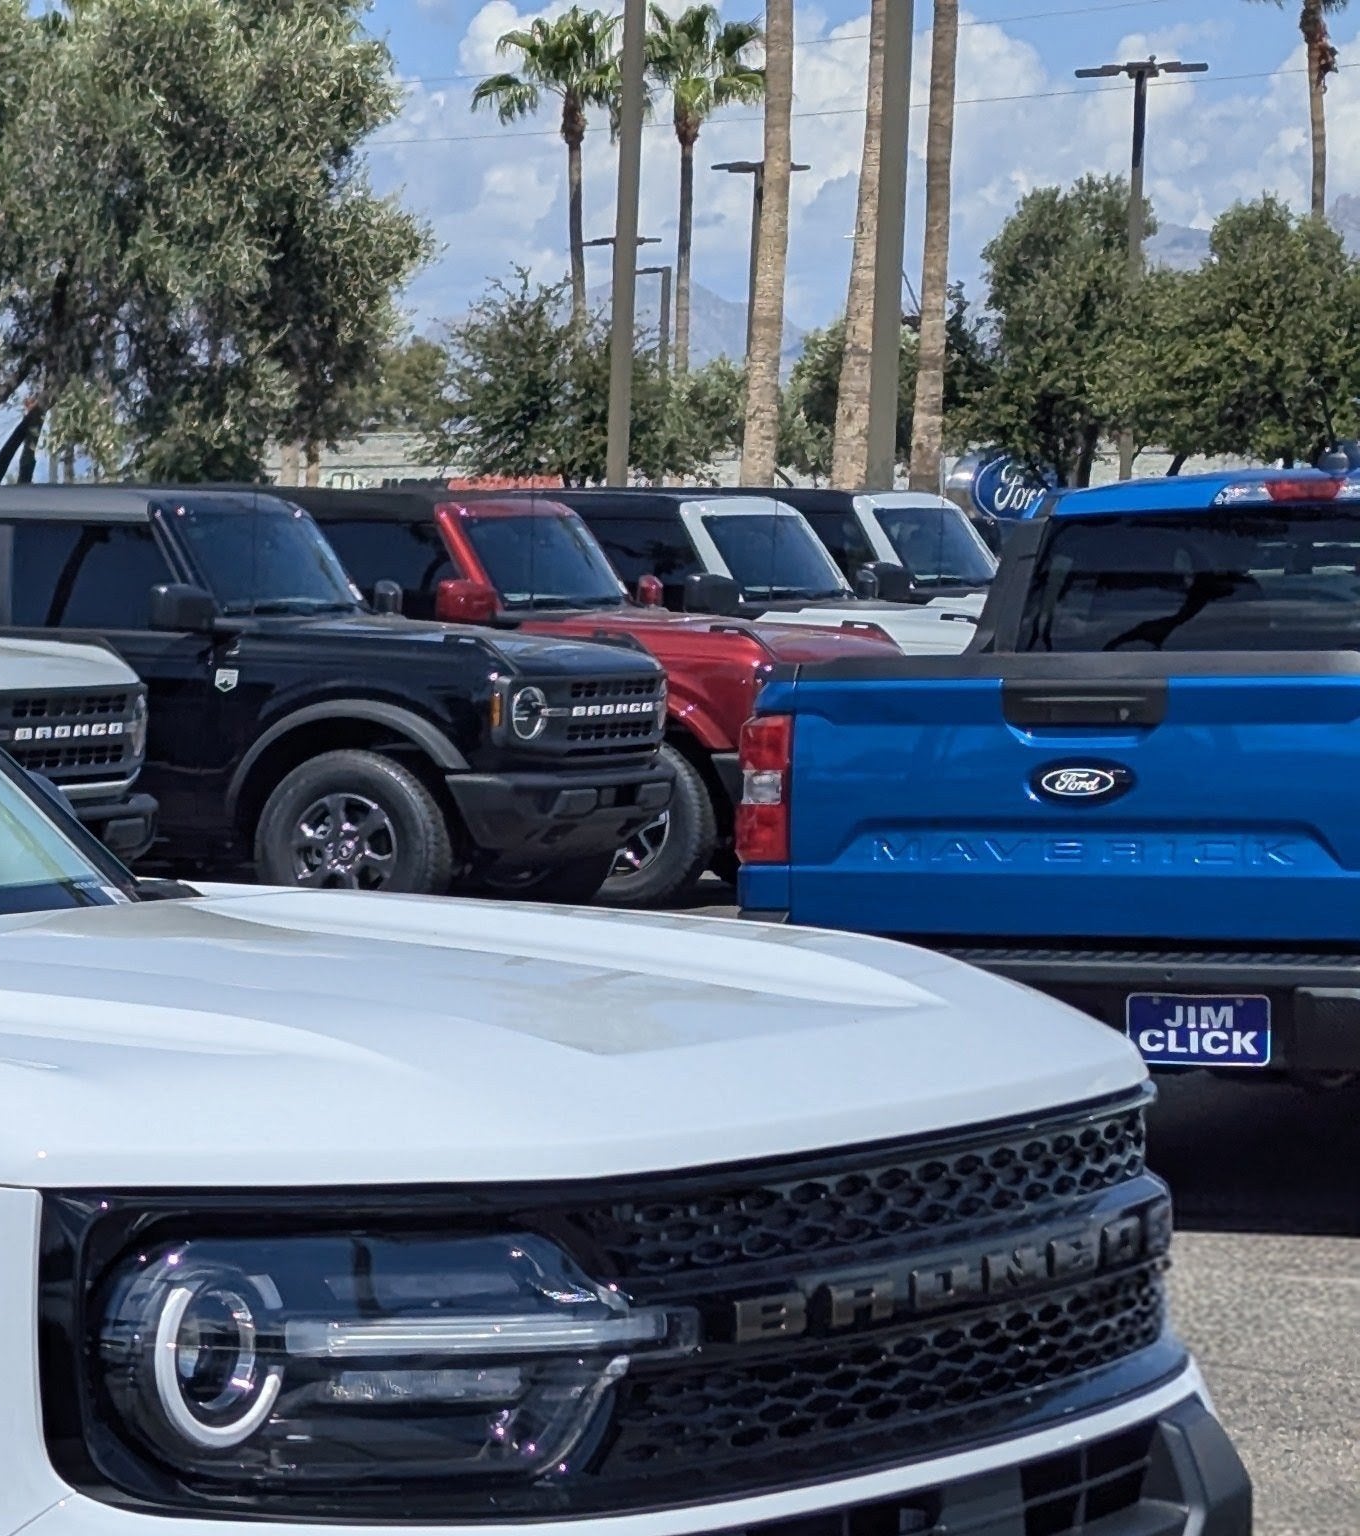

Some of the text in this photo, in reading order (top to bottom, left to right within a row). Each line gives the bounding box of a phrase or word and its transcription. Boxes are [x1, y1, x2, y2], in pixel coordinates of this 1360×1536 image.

[572, 702, 653, 717] BRONCO
[15, 722, 123, 740] BRONCO
[1055, 772, 1100, 791] Ford
[873, 838, 1295, 866] MAVERICK
[1163, 1005, 1234, 1029] JIM
[1138, 1029, 1258, 1055] CLICK
[735, 1217, 1146, 1344] BRONCO
